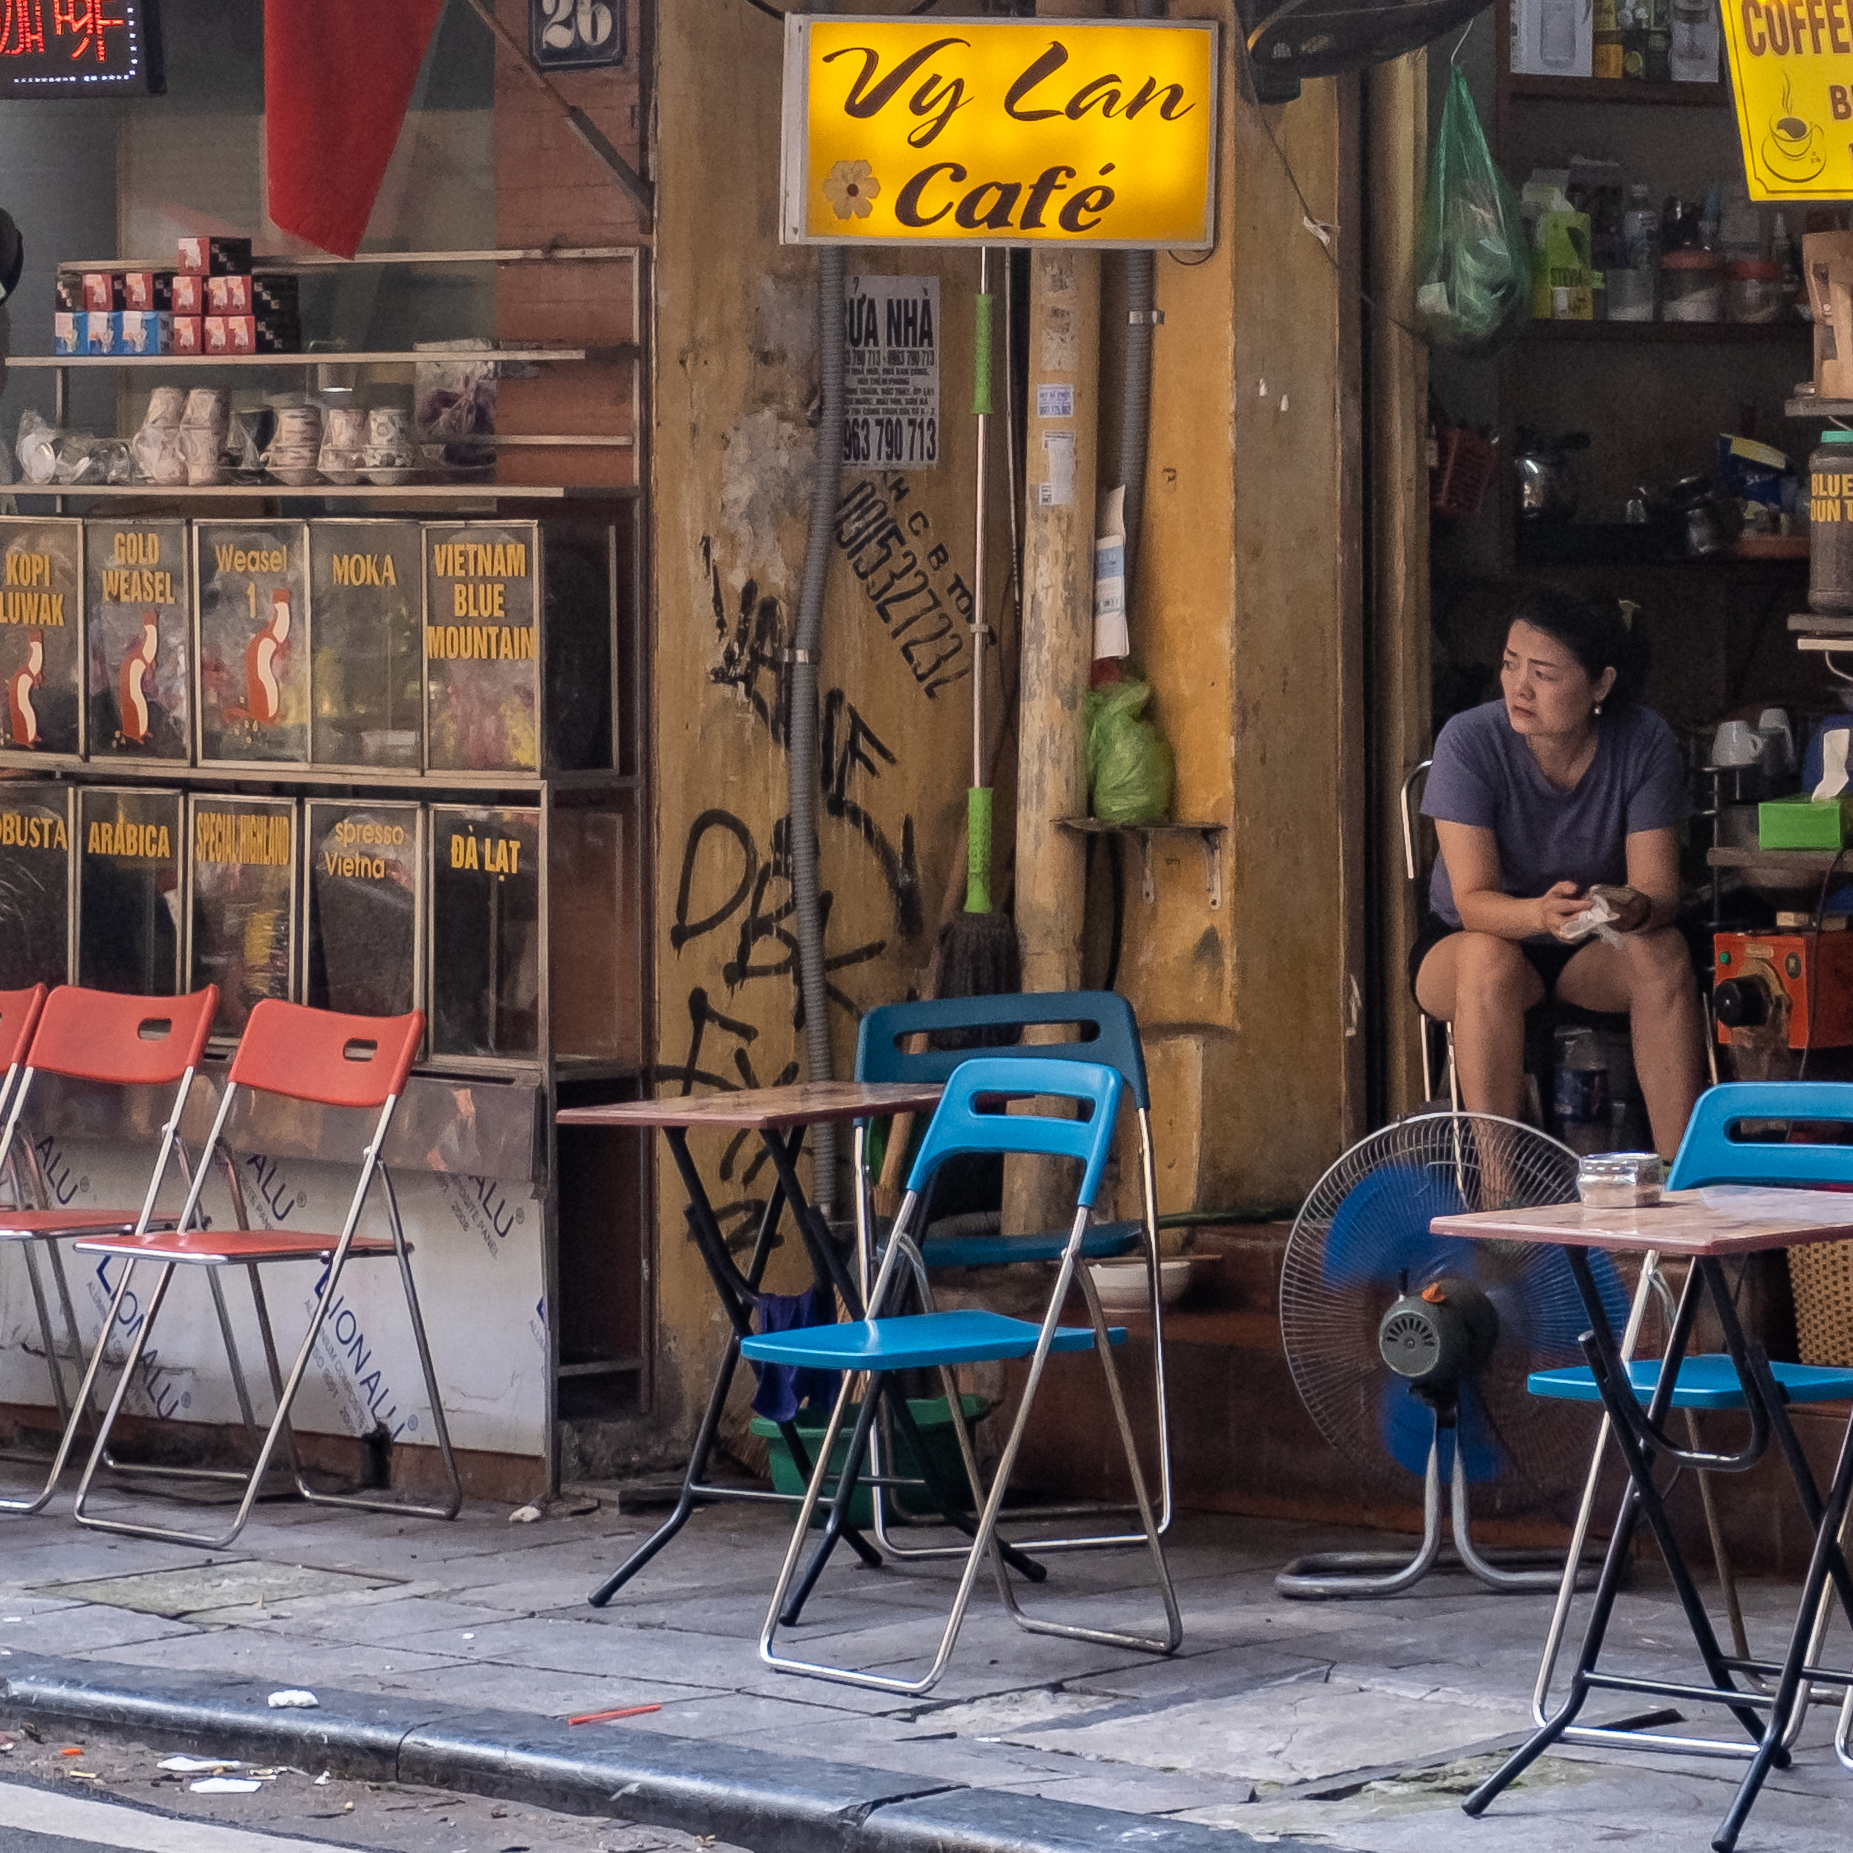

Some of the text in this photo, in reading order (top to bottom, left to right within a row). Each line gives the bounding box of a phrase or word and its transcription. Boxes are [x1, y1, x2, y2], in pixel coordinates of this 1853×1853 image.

[822, 37, 1197, 149] Vy Lan
[894, 161, 1116, 233] Café
[848, 275, 935, 348] ỬA NHÀ
[874, 417, 937, 462] 790 713
[114, 532, 159, 565] GOLD
[215, 544, 287, 573] Weasel
[434, 543, 526, 577] VIETNAM
[5, 553, 50, 587] KOPI
[102, 570, 175, 604] WEASEL
[332, 554, 396, 587] MOKA
[454, 583, 505, 617] BLUE
[427, 625, 536, 660] MOUNTAIN
[335, 821, 404, 847] spresso
[325, 851, 385, 879] Vietna
[451, 825, 521, 882] ĐÀ LẠT
[34, 1135, 79, 1206] ALU
[246, 1152, 295, 1221] ALU
[467, 1174, 515, 1238] ALU
